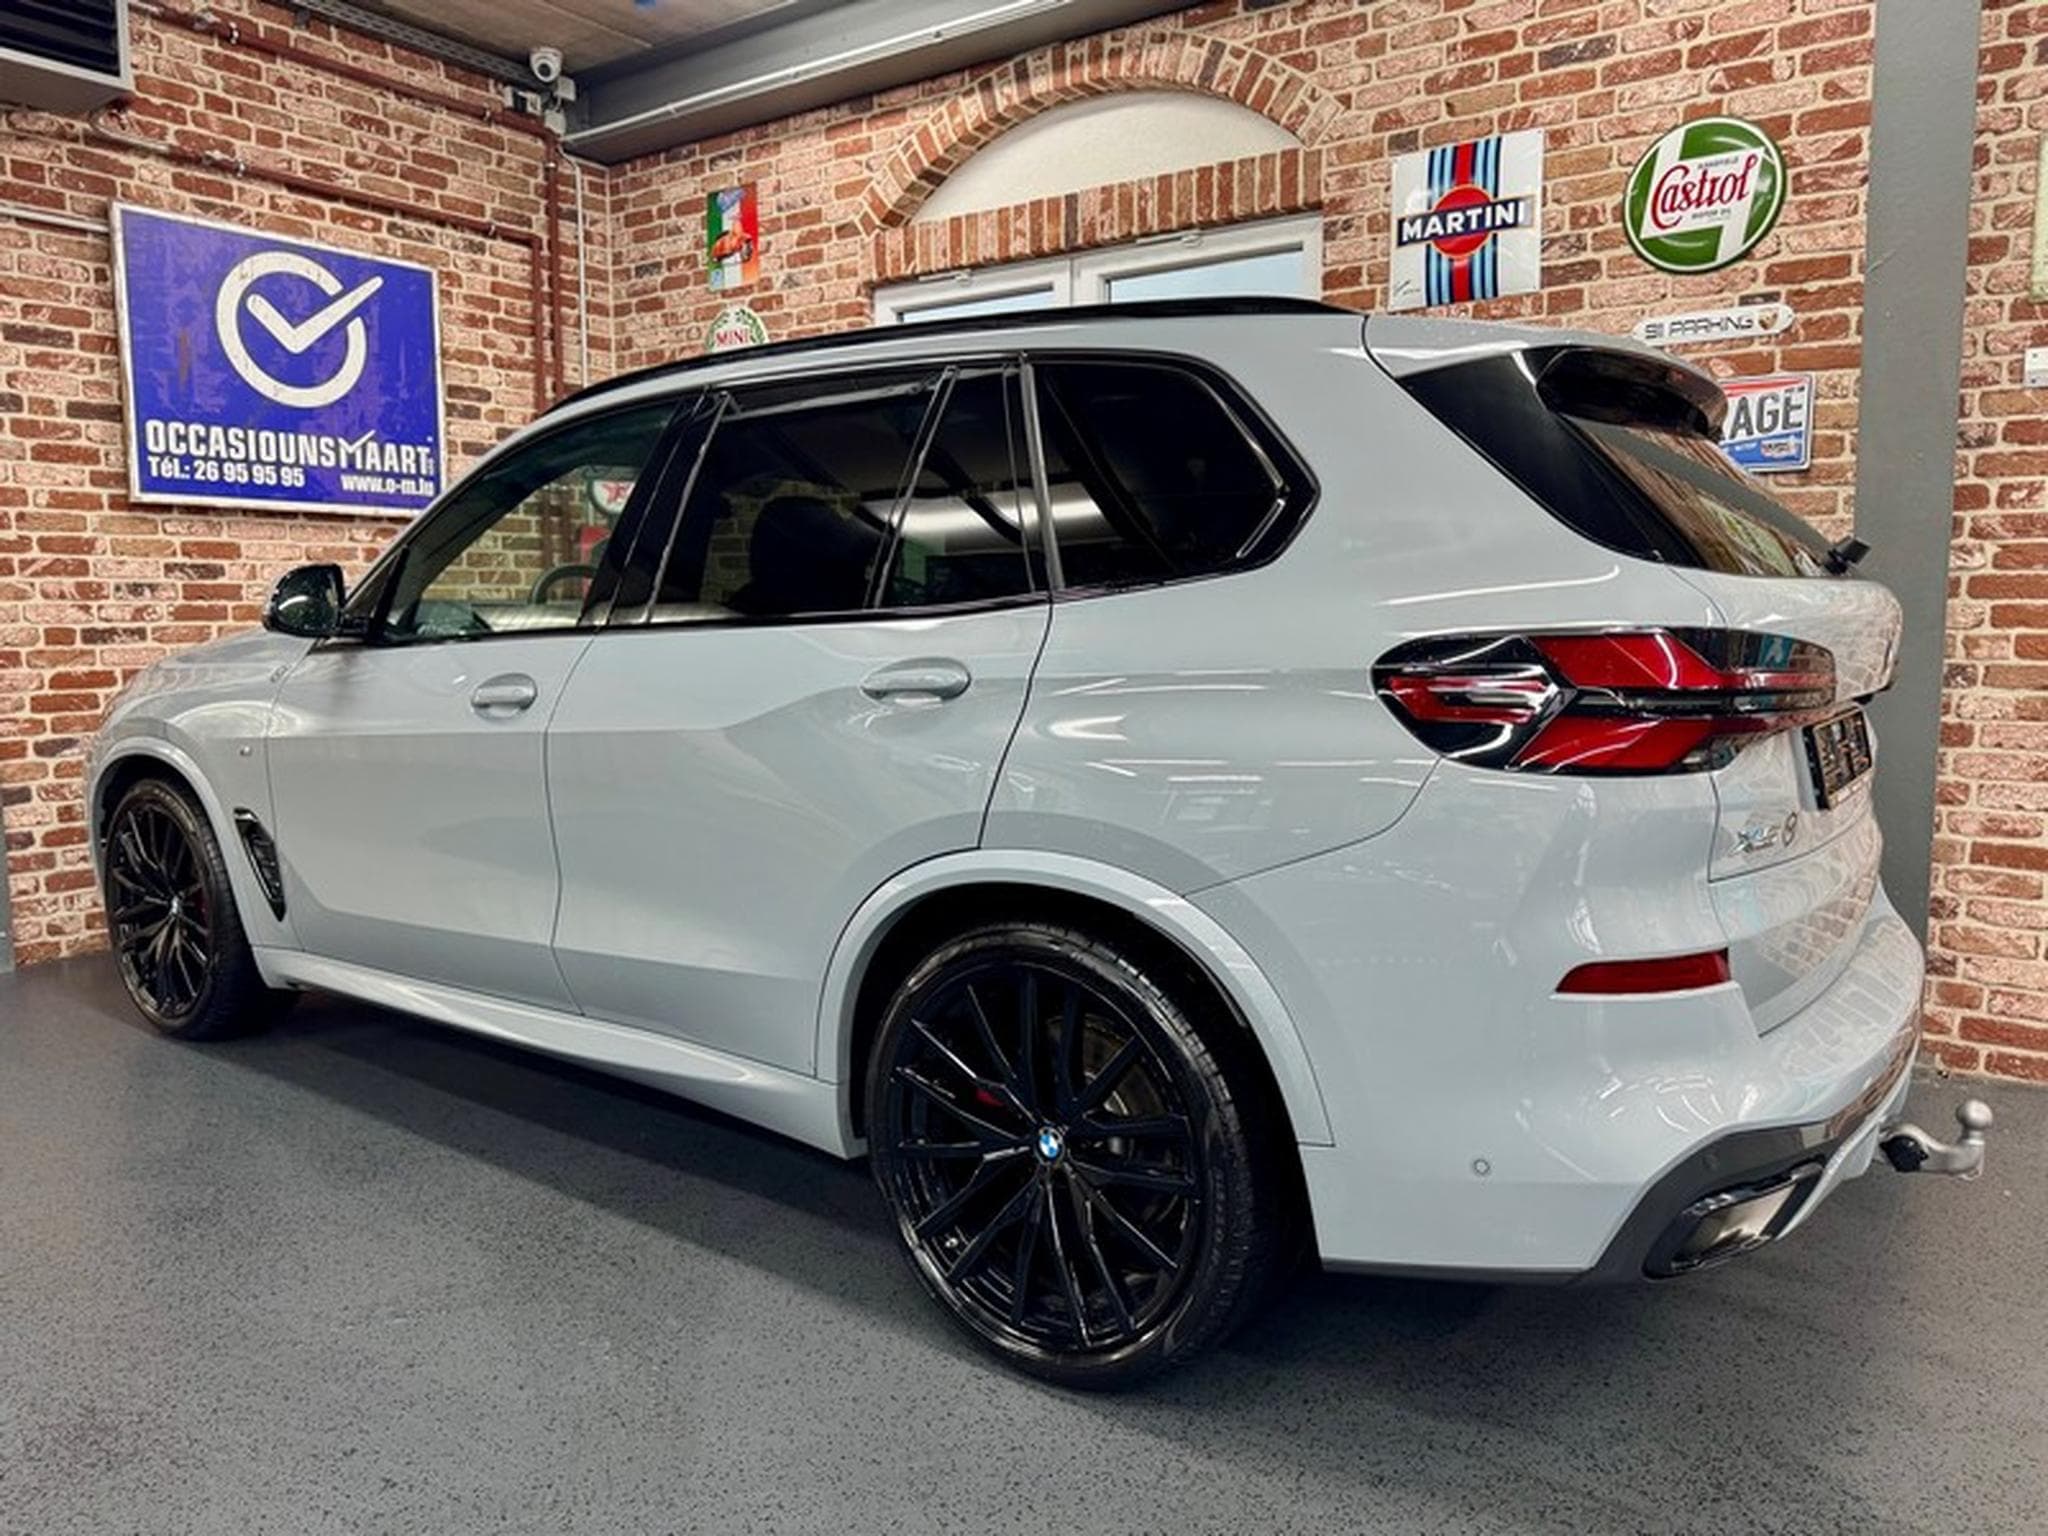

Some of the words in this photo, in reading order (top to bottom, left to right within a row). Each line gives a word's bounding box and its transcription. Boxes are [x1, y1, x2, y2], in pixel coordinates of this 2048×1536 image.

[1651, 154, 1758, 229] Castrol
[1402, 202, 1525, 242] MARTINI
[715, 329, 749, 346] MINI
[1669, 316, 1753, 337] PARKING
[1727, 386, 1806, 440] AGE
[193, 460, 219, 482] 26
[223, 461, 249, 484] 95
[252, 464, 278, 486] 95
[280, 466, 305, 488] 95
